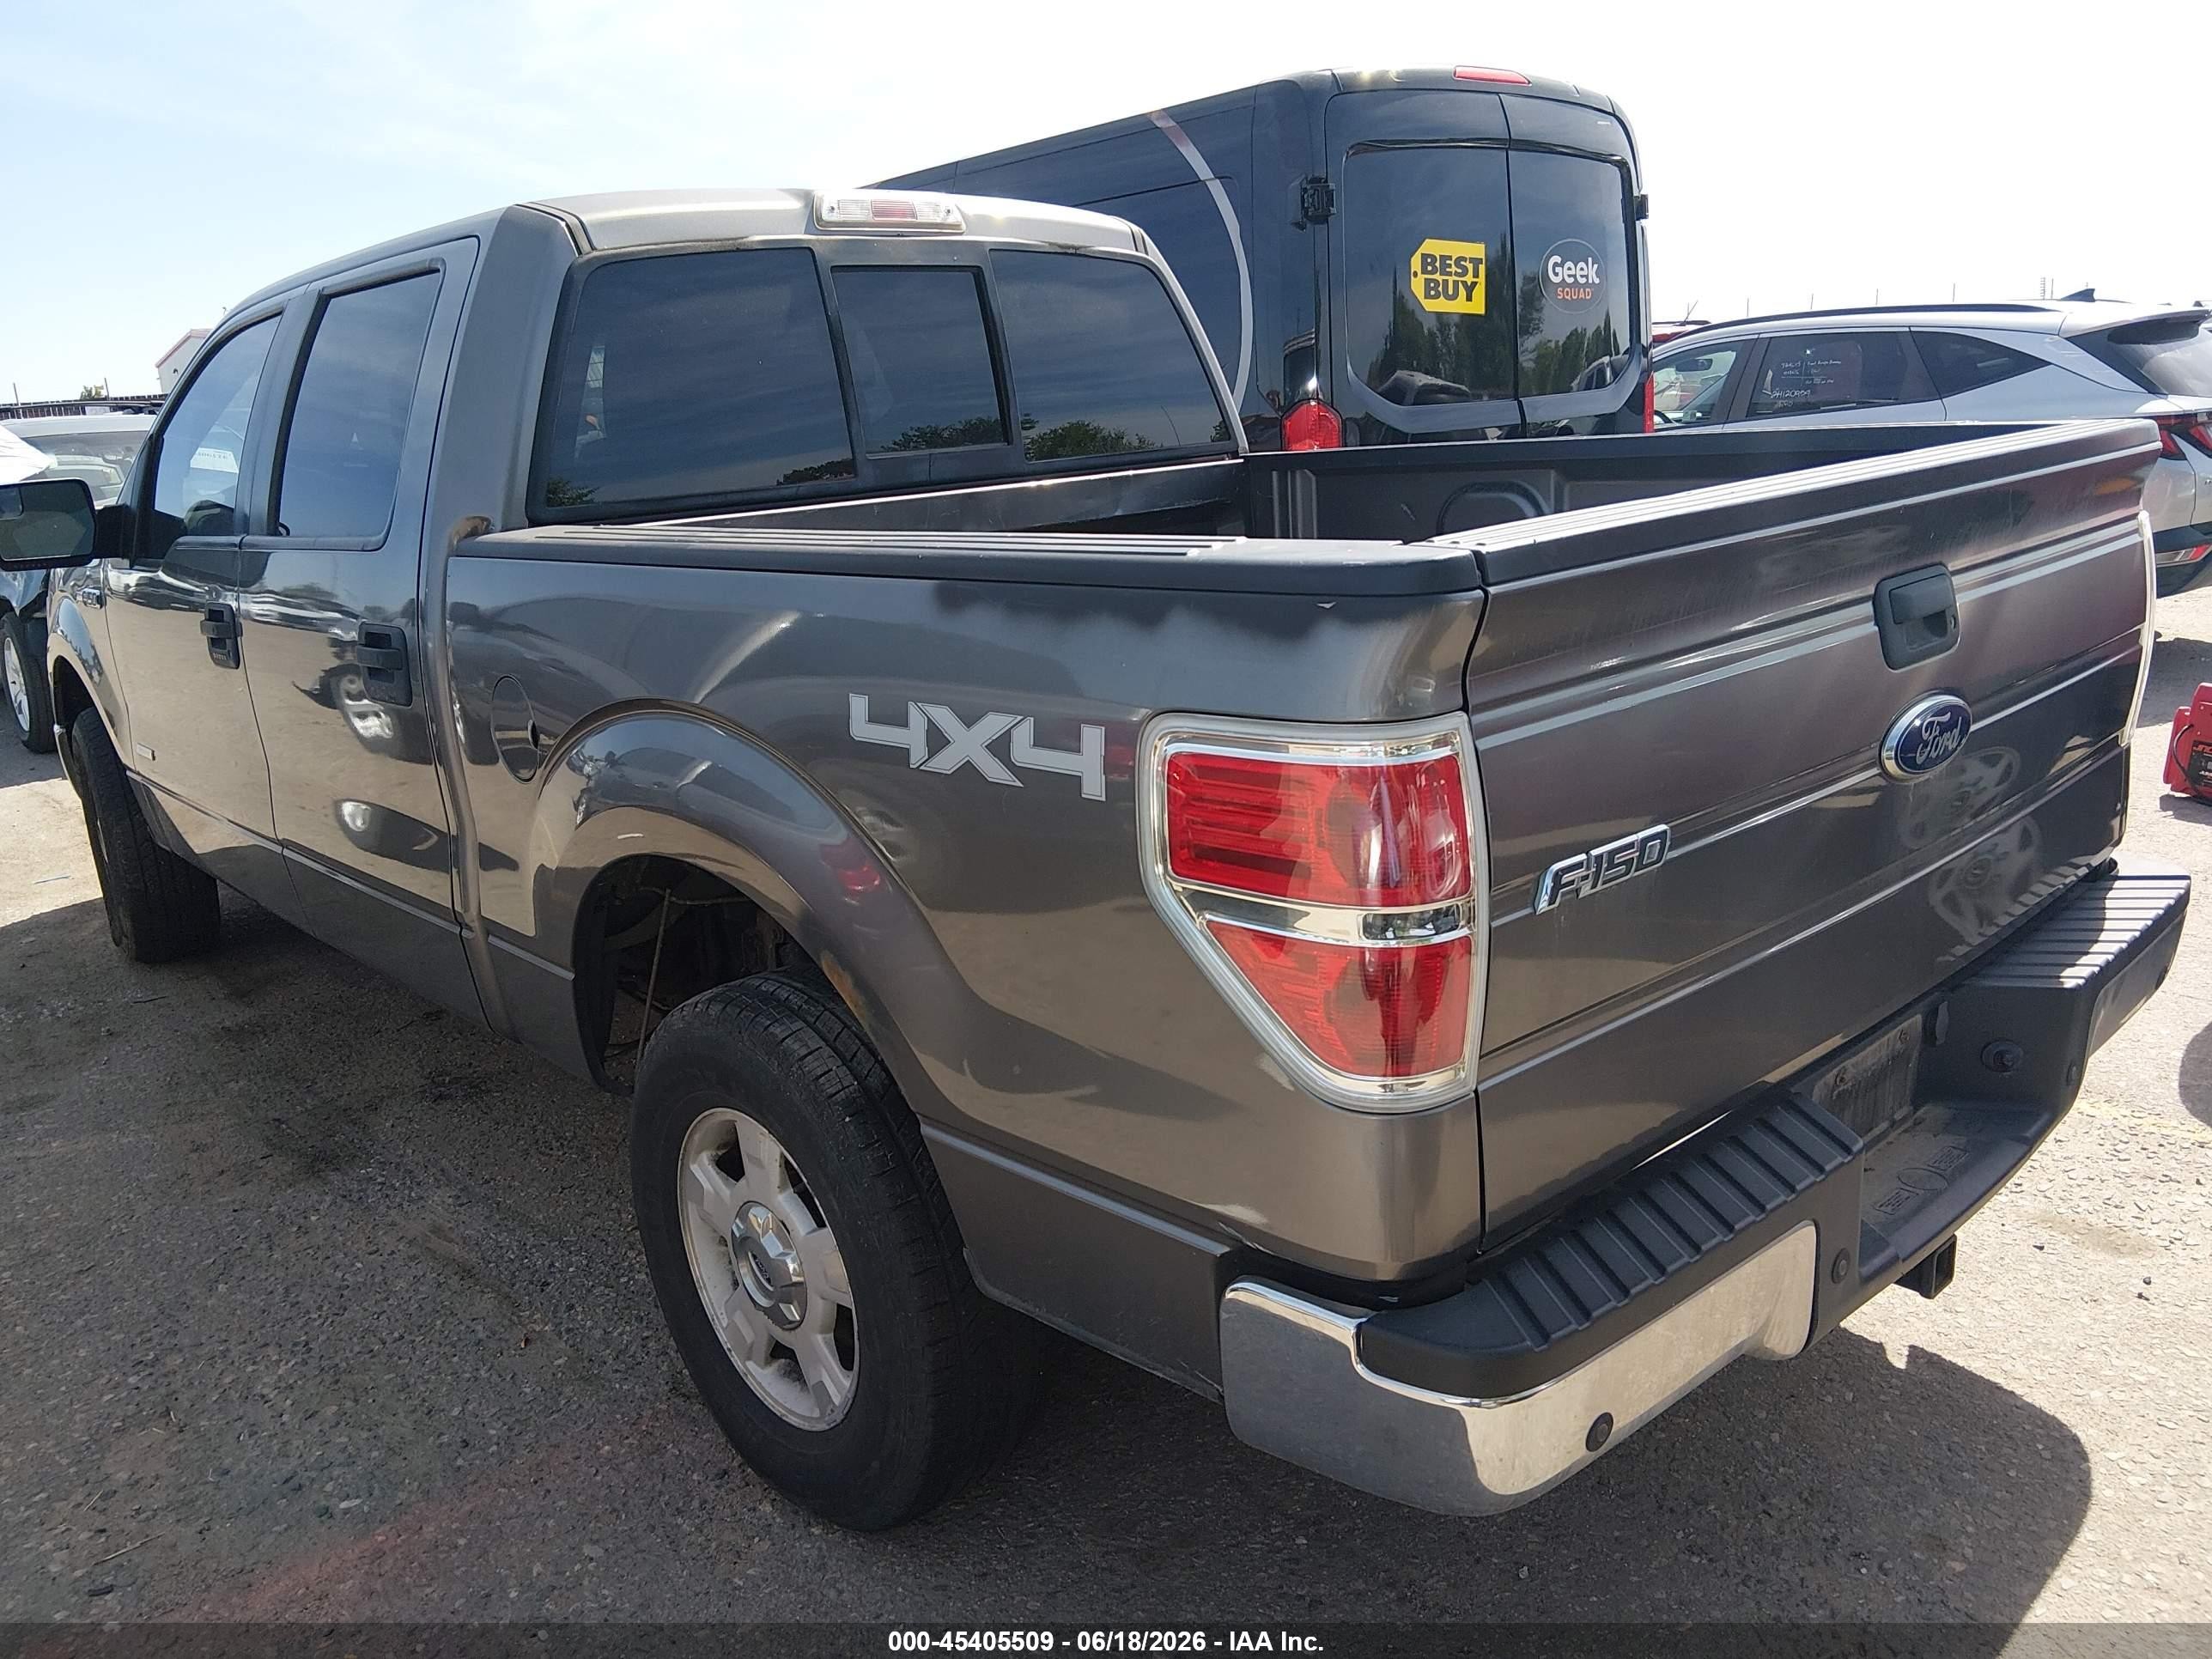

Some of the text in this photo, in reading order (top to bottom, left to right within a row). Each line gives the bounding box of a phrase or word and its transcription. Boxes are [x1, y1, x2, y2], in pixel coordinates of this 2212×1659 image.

[1421, 252, 1484, 278] BEST
[1547, 255, 1601, 283] Geek
[1424, 277, 1479, 302] BUY
[1557, 288, 1592, 300] SQUAD
[1916, 711, 1961, 764] Ford
[1534, 823, 1671, 915] F-150
